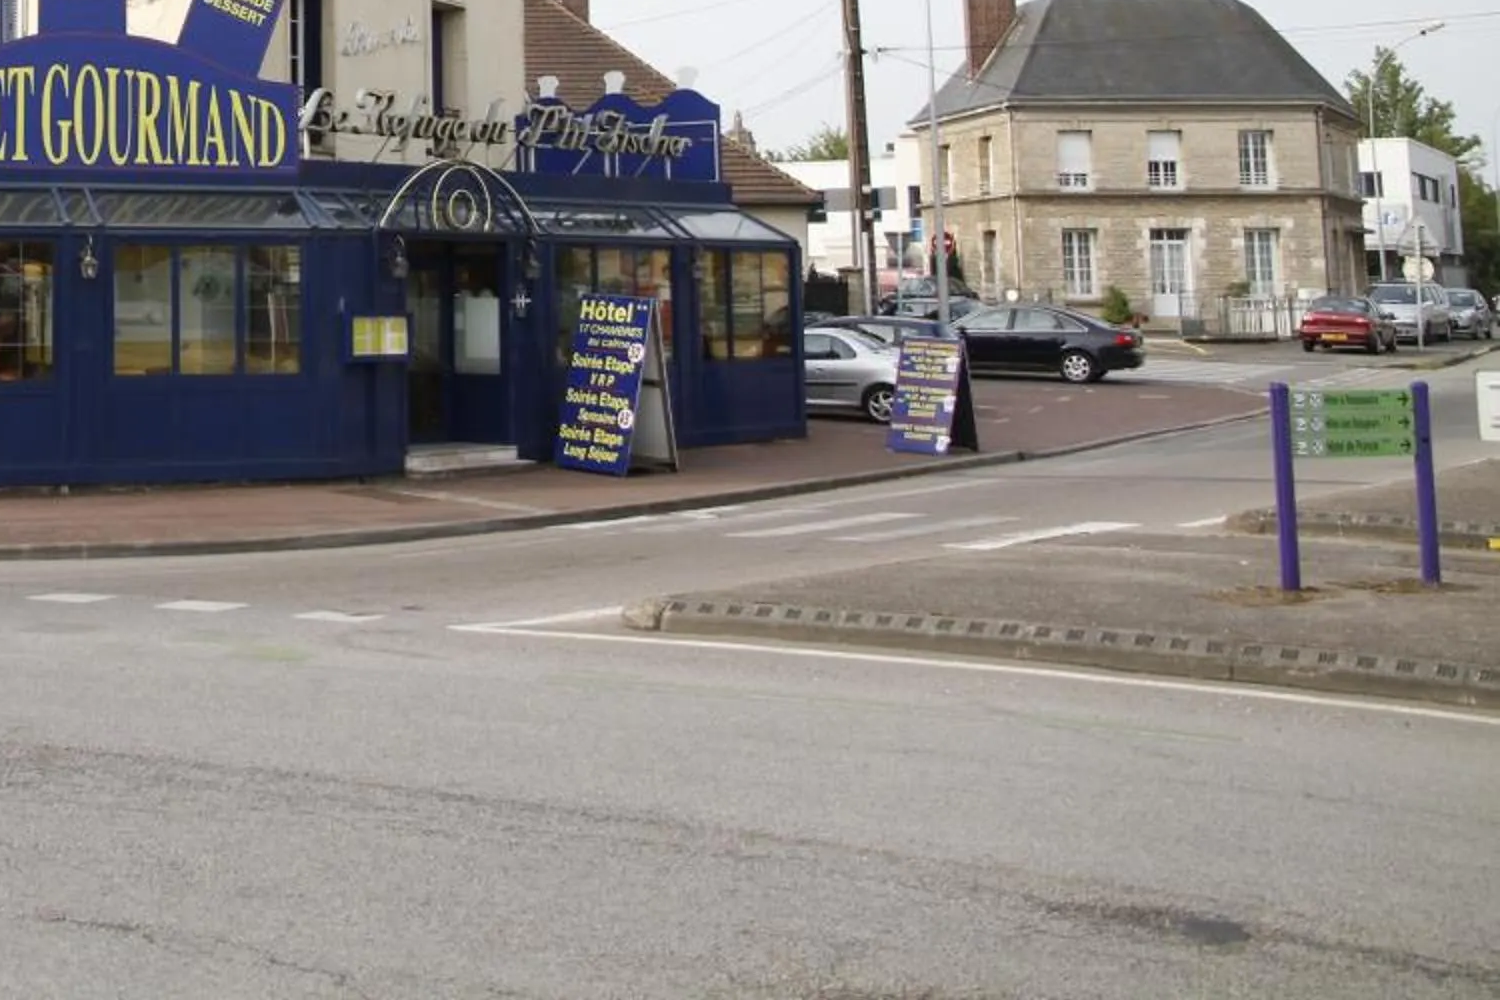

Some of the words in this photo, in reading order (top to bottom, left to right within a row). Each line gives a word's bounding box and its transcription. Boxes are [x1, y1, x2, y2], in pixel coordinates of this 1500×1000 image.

[41, 63, 286, 169] GOURMAND
[355, 89, 466, 153] Refuge
[580, 299, 634, 323] Hôtel
